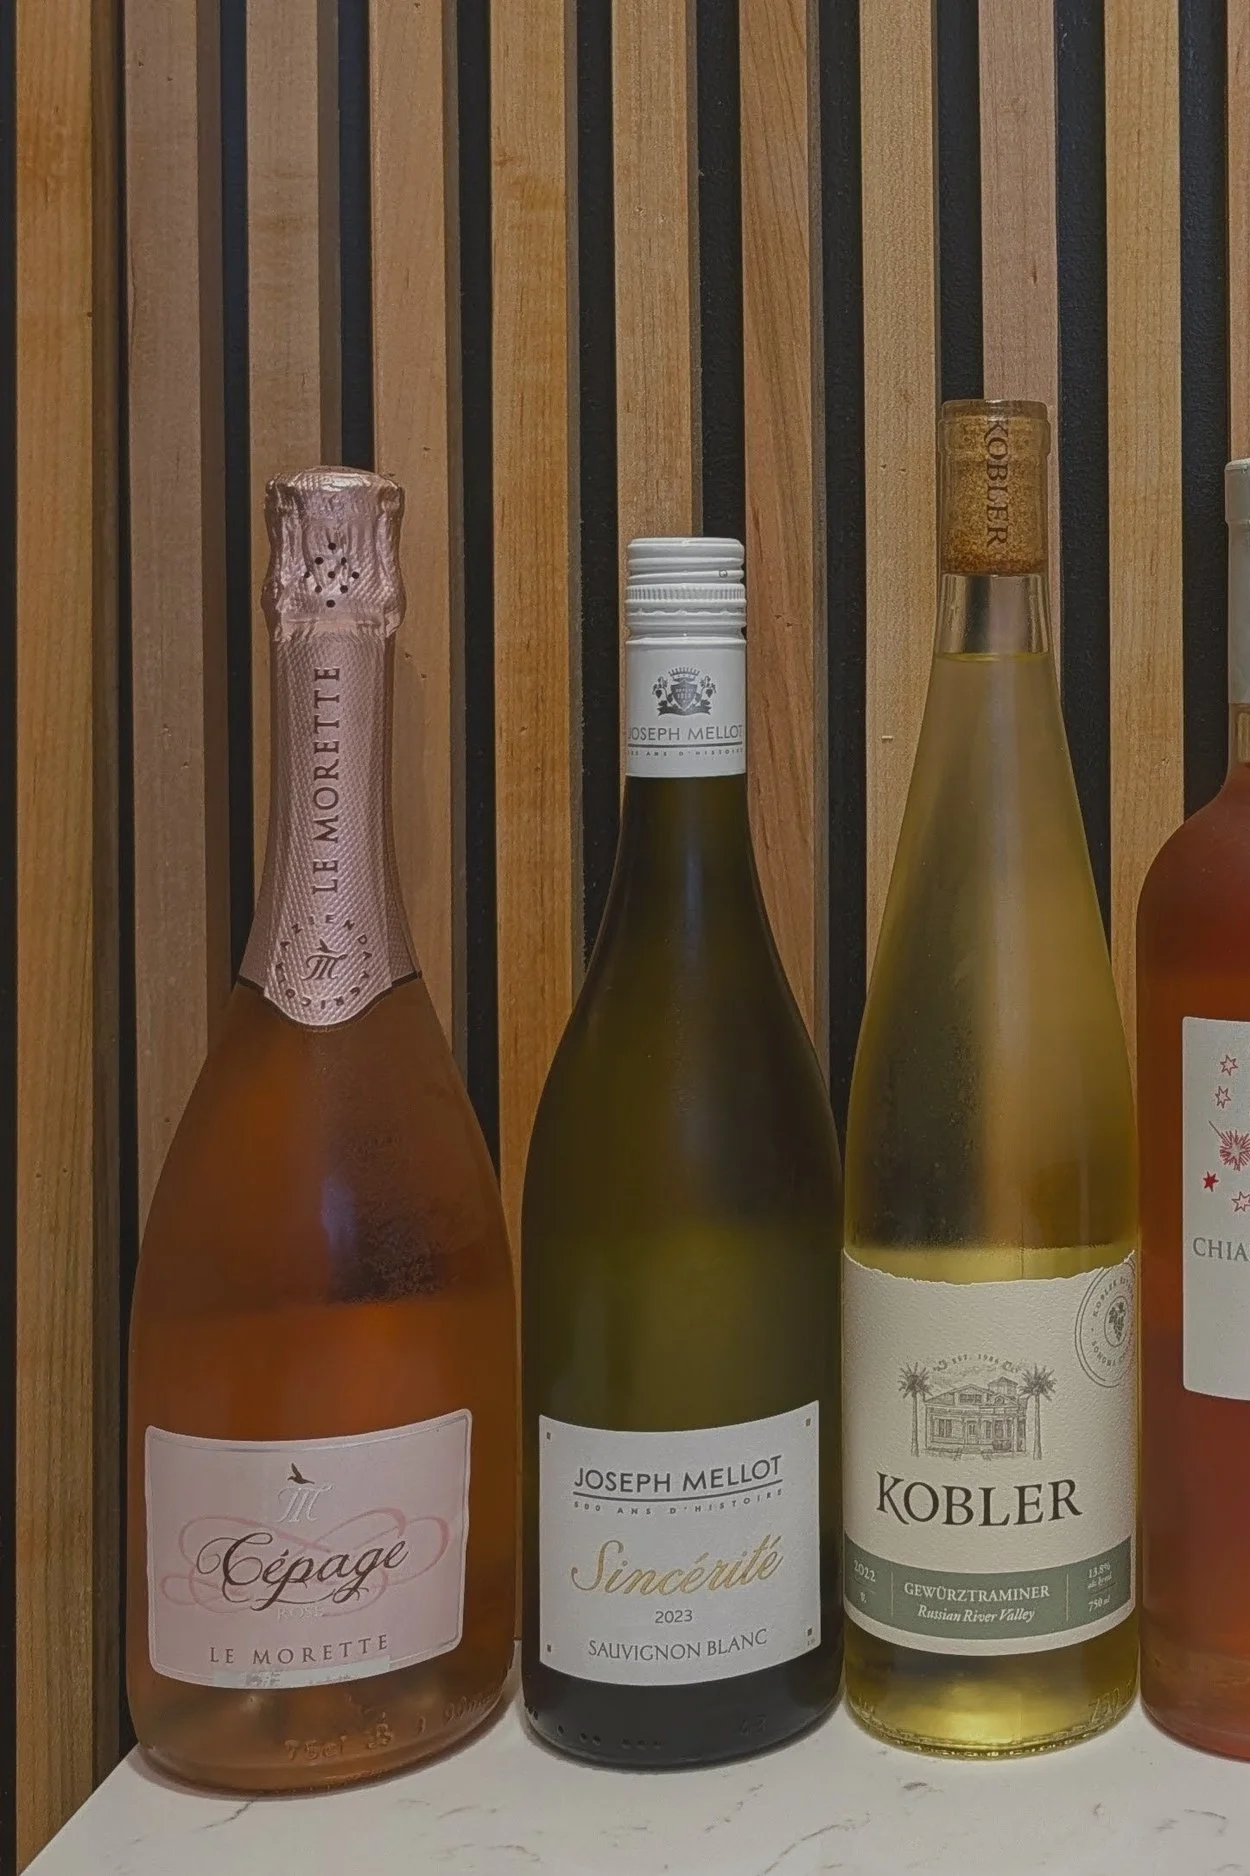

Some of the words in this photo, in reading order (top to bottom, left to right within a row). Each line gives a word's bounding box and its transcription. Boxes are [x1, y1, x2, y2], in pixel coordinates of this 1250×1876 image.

[983, 420, 1009, 547] KOBLER
[313, 667, 341, 844] MORETTE
[312, 858, 339, 894] LE
[574, 1466, 672, 1494] JOSEPH
[682, 1454, 783, 1493] MELLOT
[617, 1506, 652, 1516] ANS
[669, 1488, 784, 1515] D'HISTOIRE
[876, 1471, 1083, 1527] KOBLER
[196, 1532, 410, 1612] Cépage
[570, 1534, 785, 1596] Sincérité
[853, 1559, 876, 1582] 2022
[904, 1581, 1050, 1602] GEWÜRZTRAMINER
[654, 1609, 693, 1624] 2023
[917, 1604, 961, 1622] Russian
[962, 1608, 997, 1622] River
[999, 1608, 1036, 1625] Valley
[209, 1646, 234, 1664] LE
[252, 1633, 389, 1666] MORETTE
[588, 1640, 700, 1661] SAUVIGNON
[707, 1628, 768, 1656] BLANC
